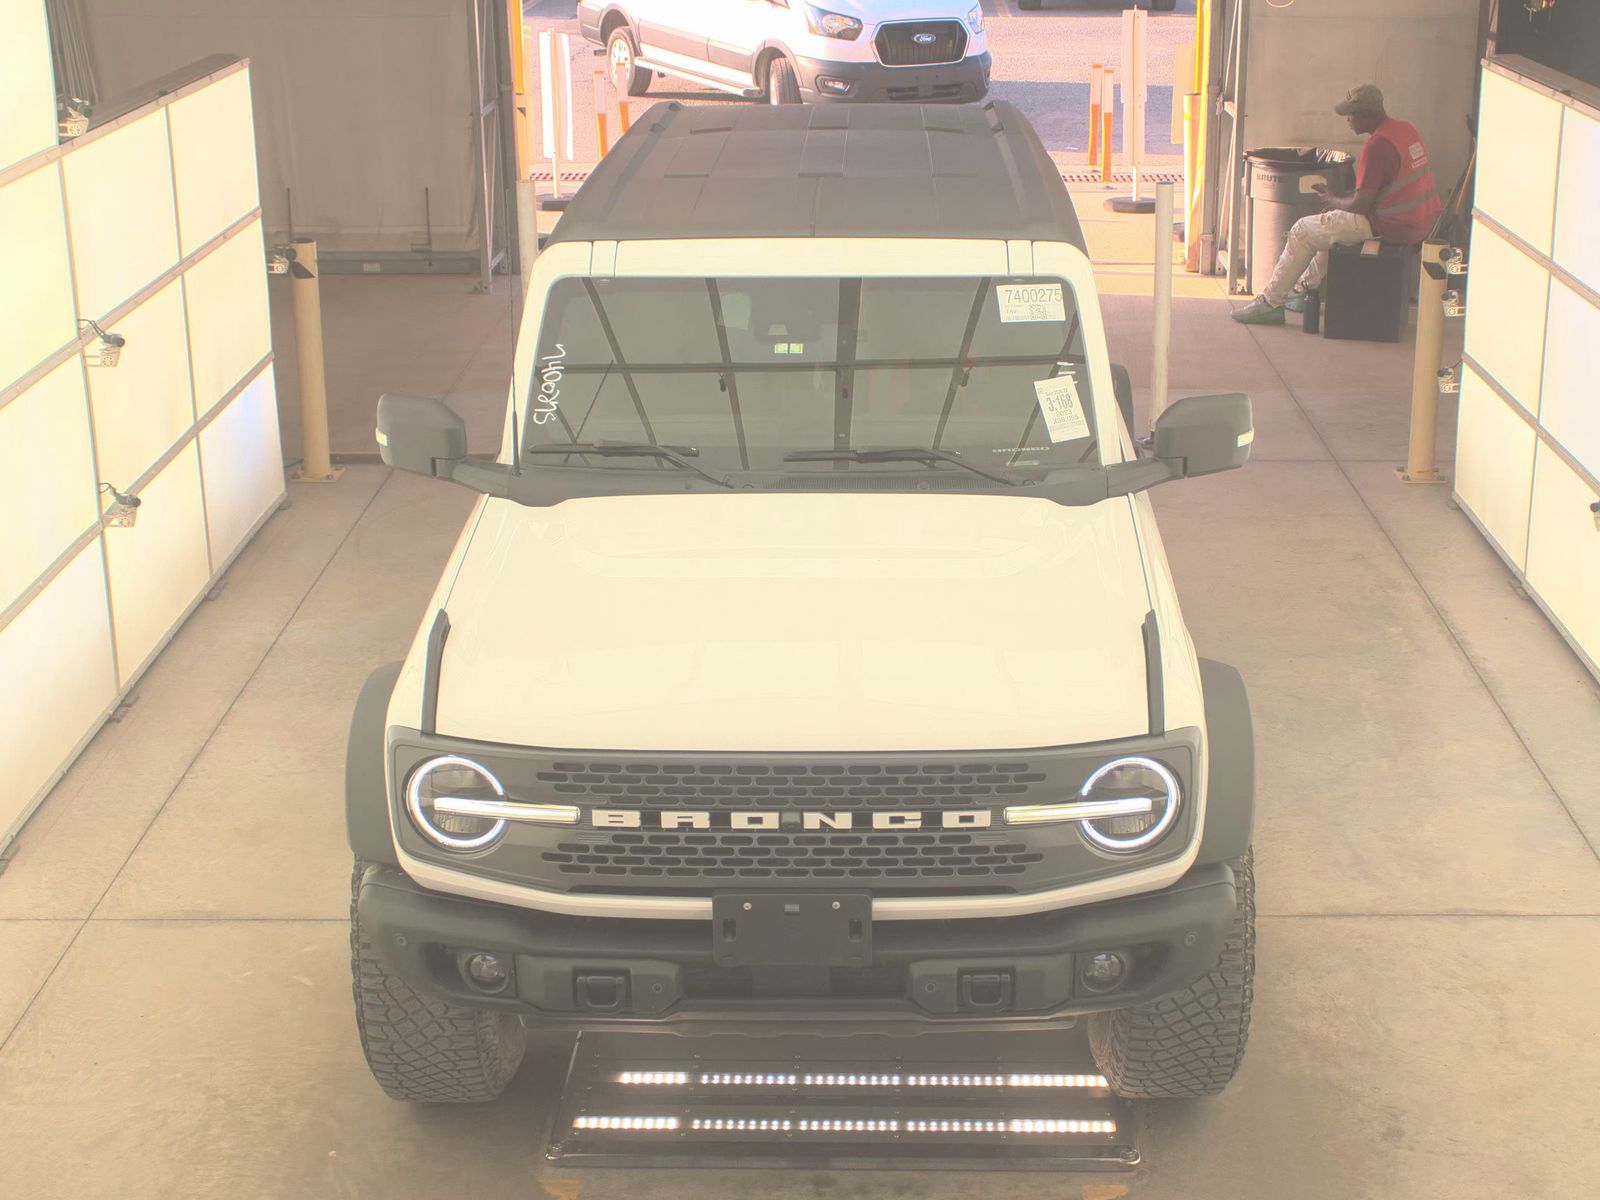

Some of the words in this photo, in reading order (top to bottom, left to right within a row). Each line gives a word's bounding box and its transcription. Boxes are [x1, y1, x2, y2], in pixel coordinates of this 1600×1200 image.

[1256, 172, 1283, 183] BRUTE
[1005, 289, 1063, 303] 7400275
[1046, 393, 1074, 412] 3:168
[591, 809, 992, 829] BRONCO
